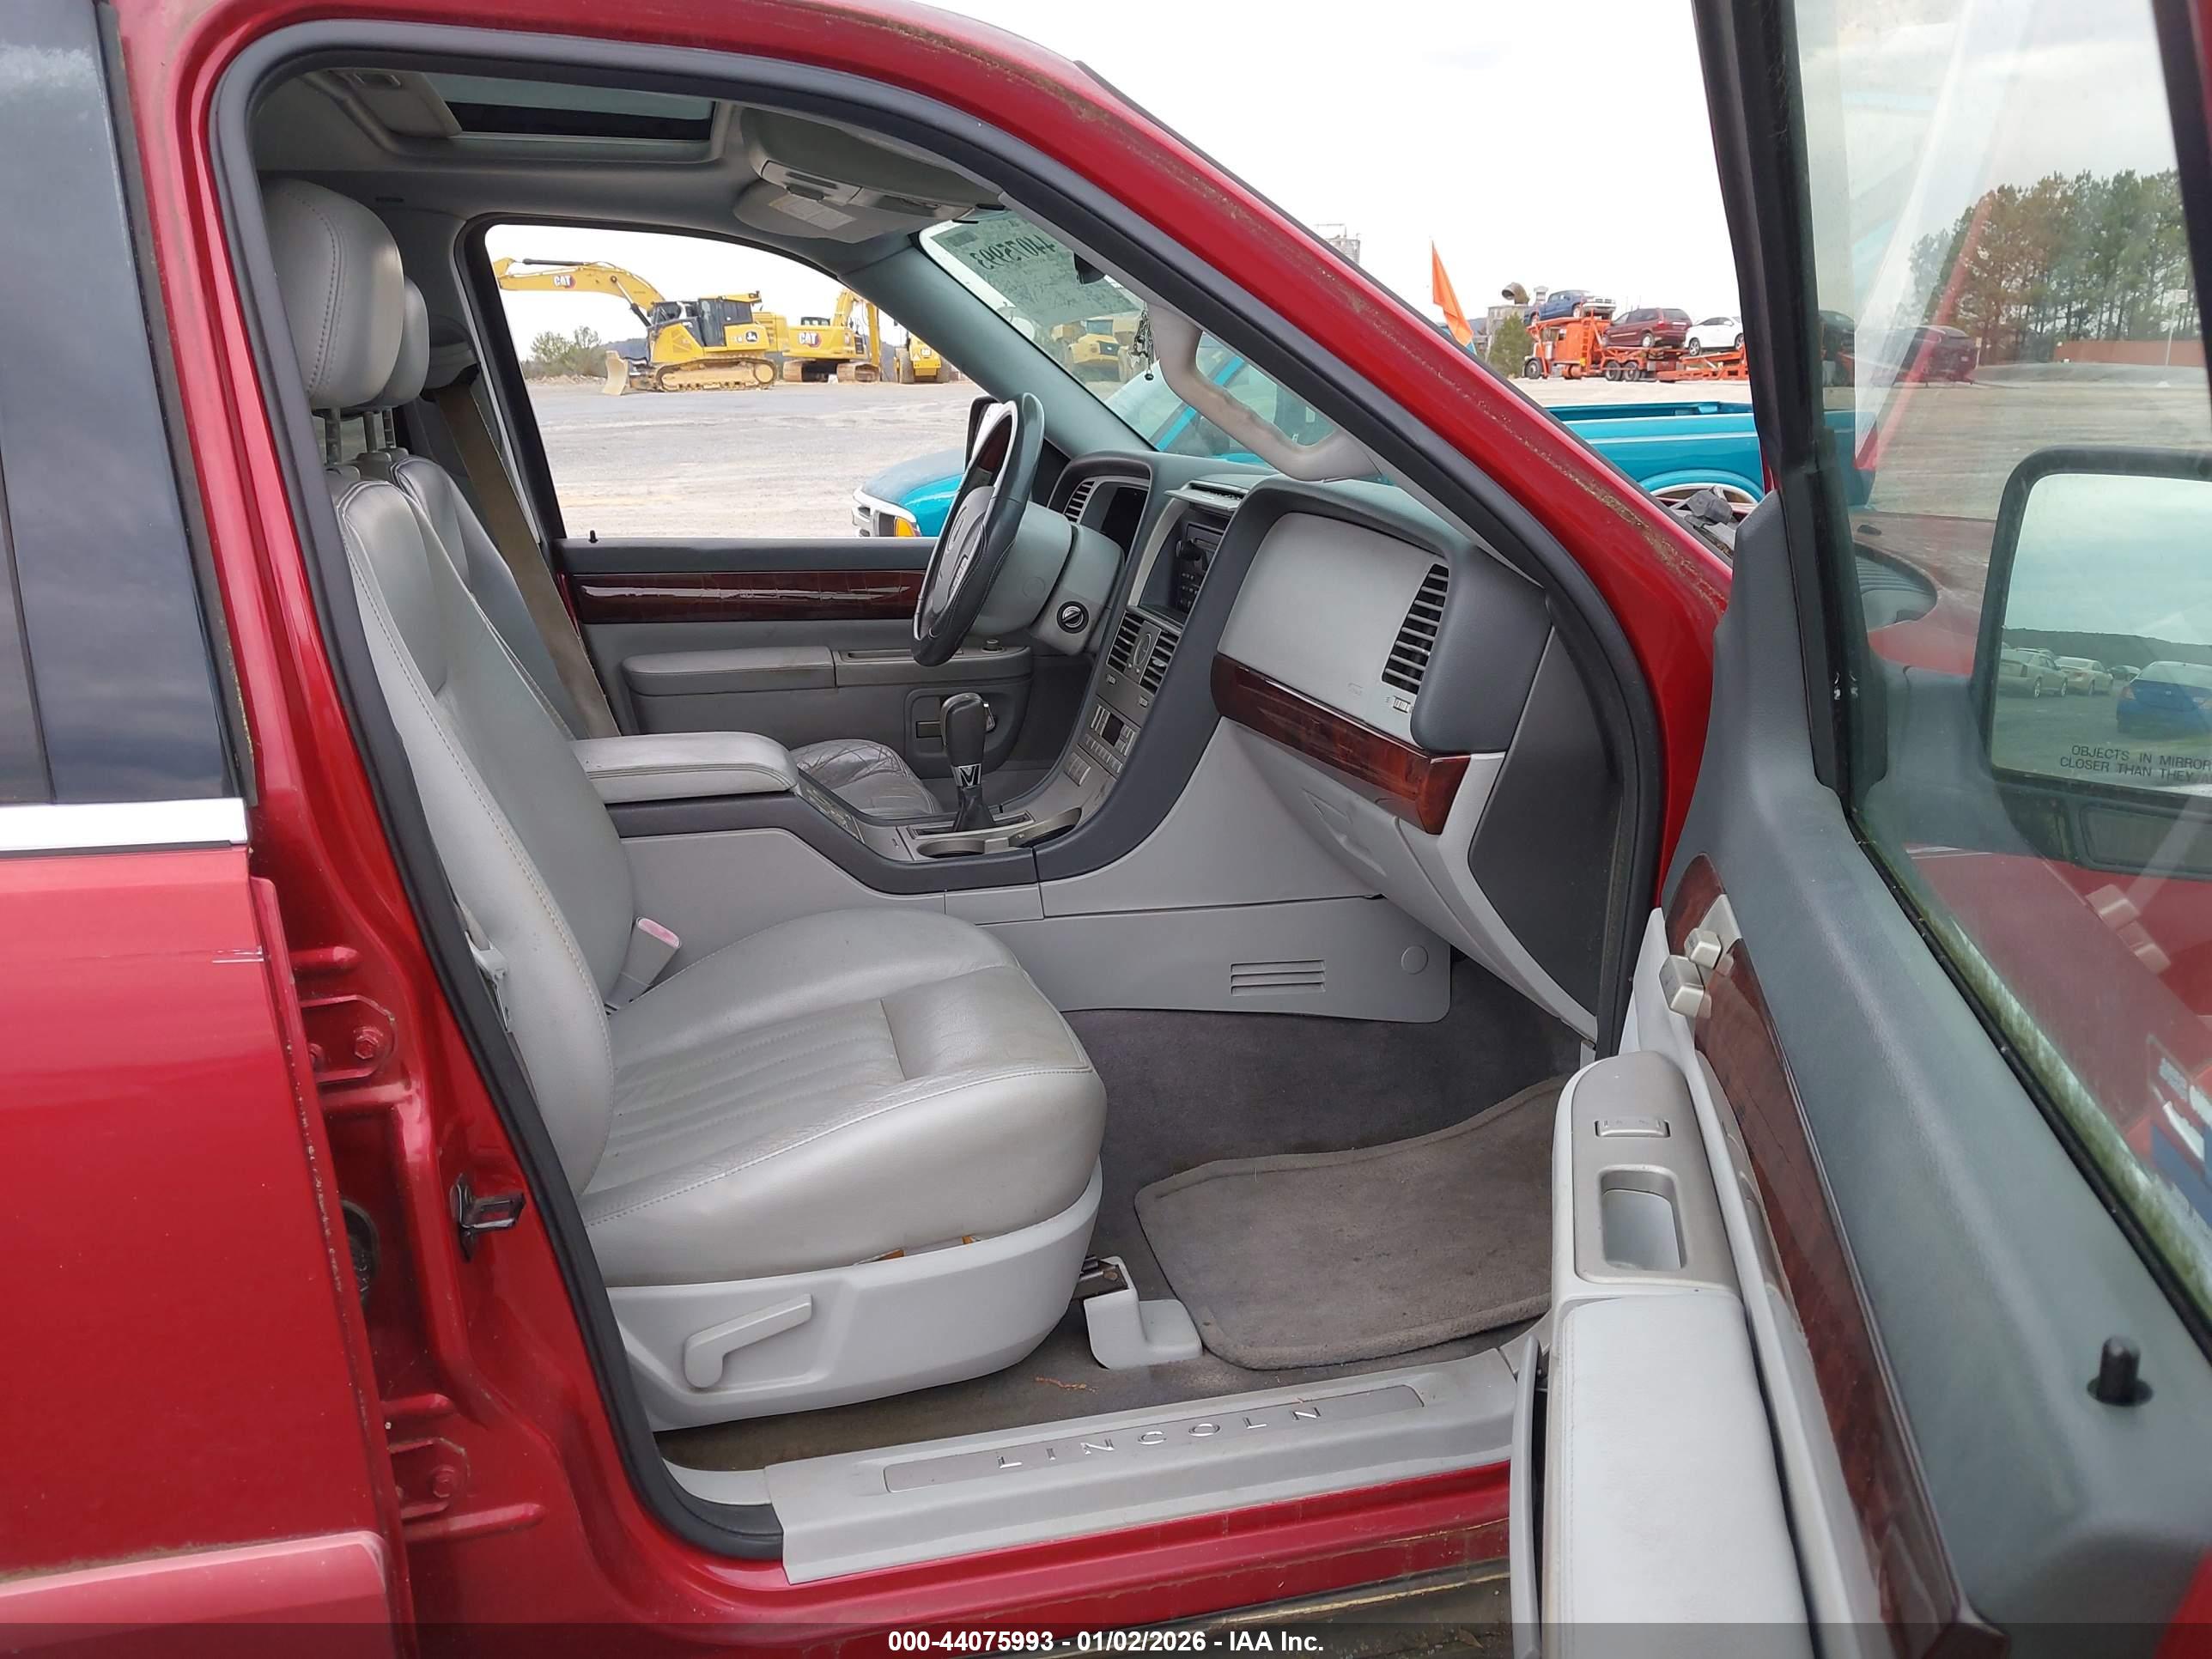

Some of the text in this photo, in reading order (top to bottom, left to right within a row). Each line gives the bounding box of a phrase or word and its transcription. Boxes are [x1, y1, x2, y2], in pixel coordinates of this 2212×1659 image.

[554, 275, 571, 287] CAT
[799, 331, 817, 345] CAT
[2060, 757, 2110, 773] CLOSER
[2118, 763, 2152, 777] THAN
[2160, 768, 2194, 783] THEY
[2071, 744, 2212, 771] OBJECTS IN MIRROR
[996, 1407, 1322, 1469] LINCOLN
